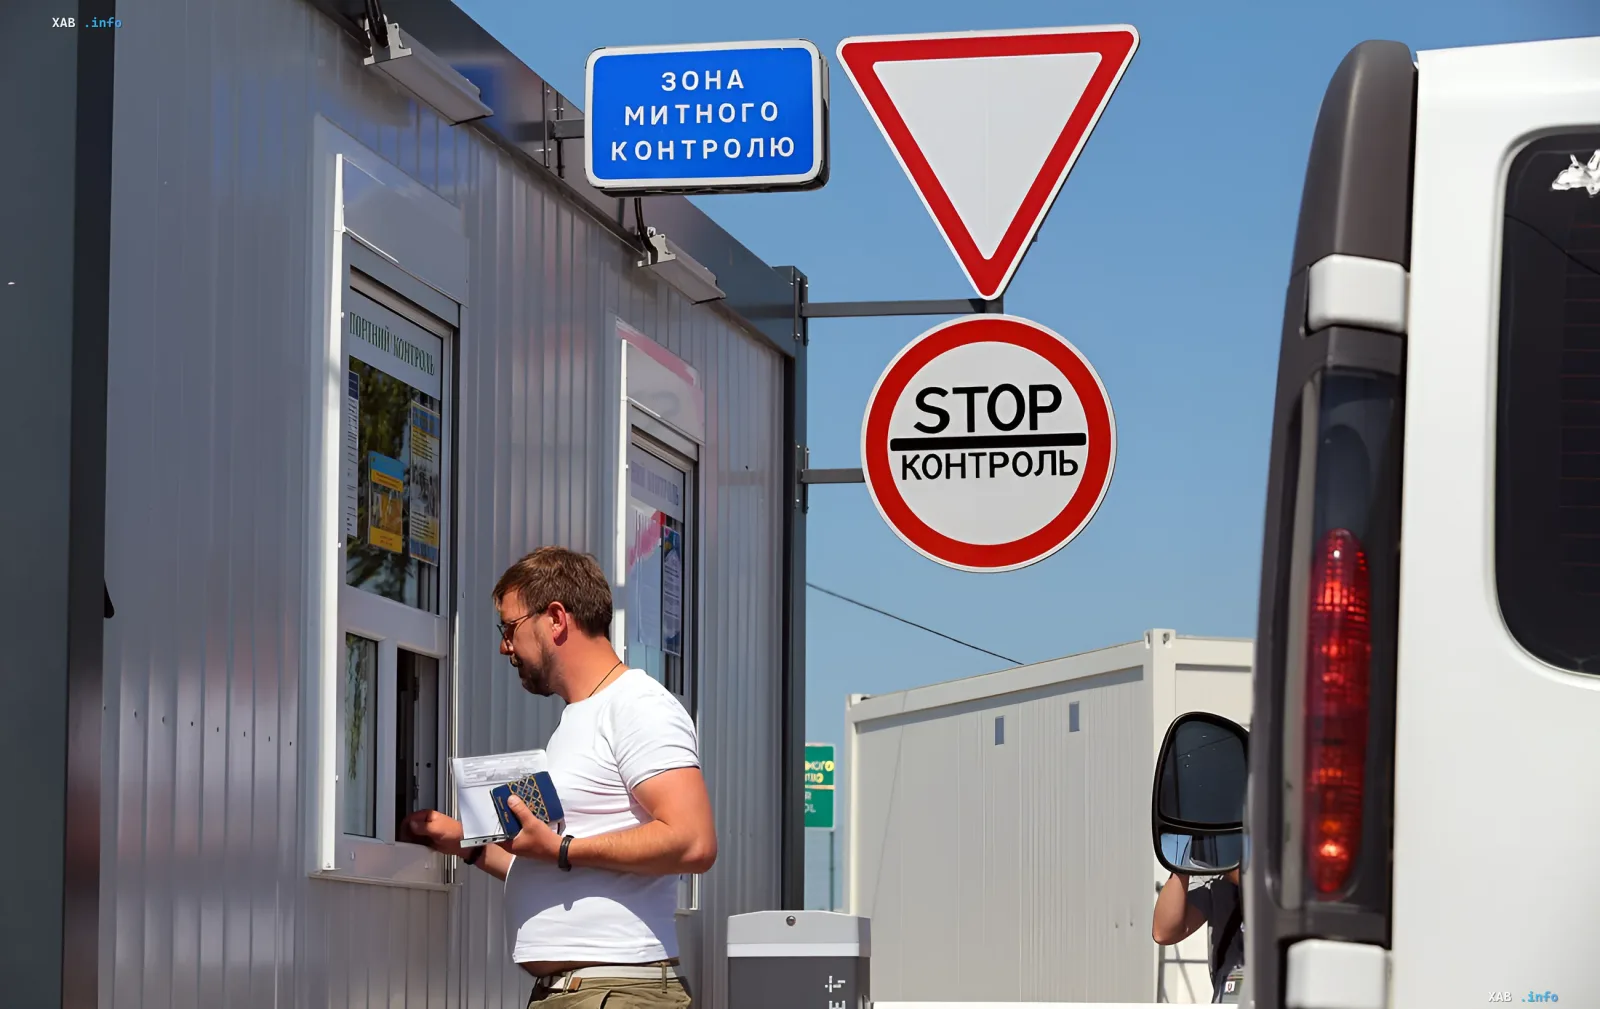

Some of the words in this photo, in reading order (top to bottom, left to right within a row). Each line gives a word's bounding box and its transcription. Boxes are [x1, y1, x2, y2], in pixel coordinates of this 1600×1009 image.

[661, 69, 745, 92] ЗОНА
[624, 101, 778, 126] МИТНОГО
[611, 136, 795, 161] КОНТРОЛЮ
[393, 334, 435, 376] КОНТРОЛЬ
[913, 383, 1063, 434] STOP
[901, 450, 1079, 480] КОНТРОЛЬ
